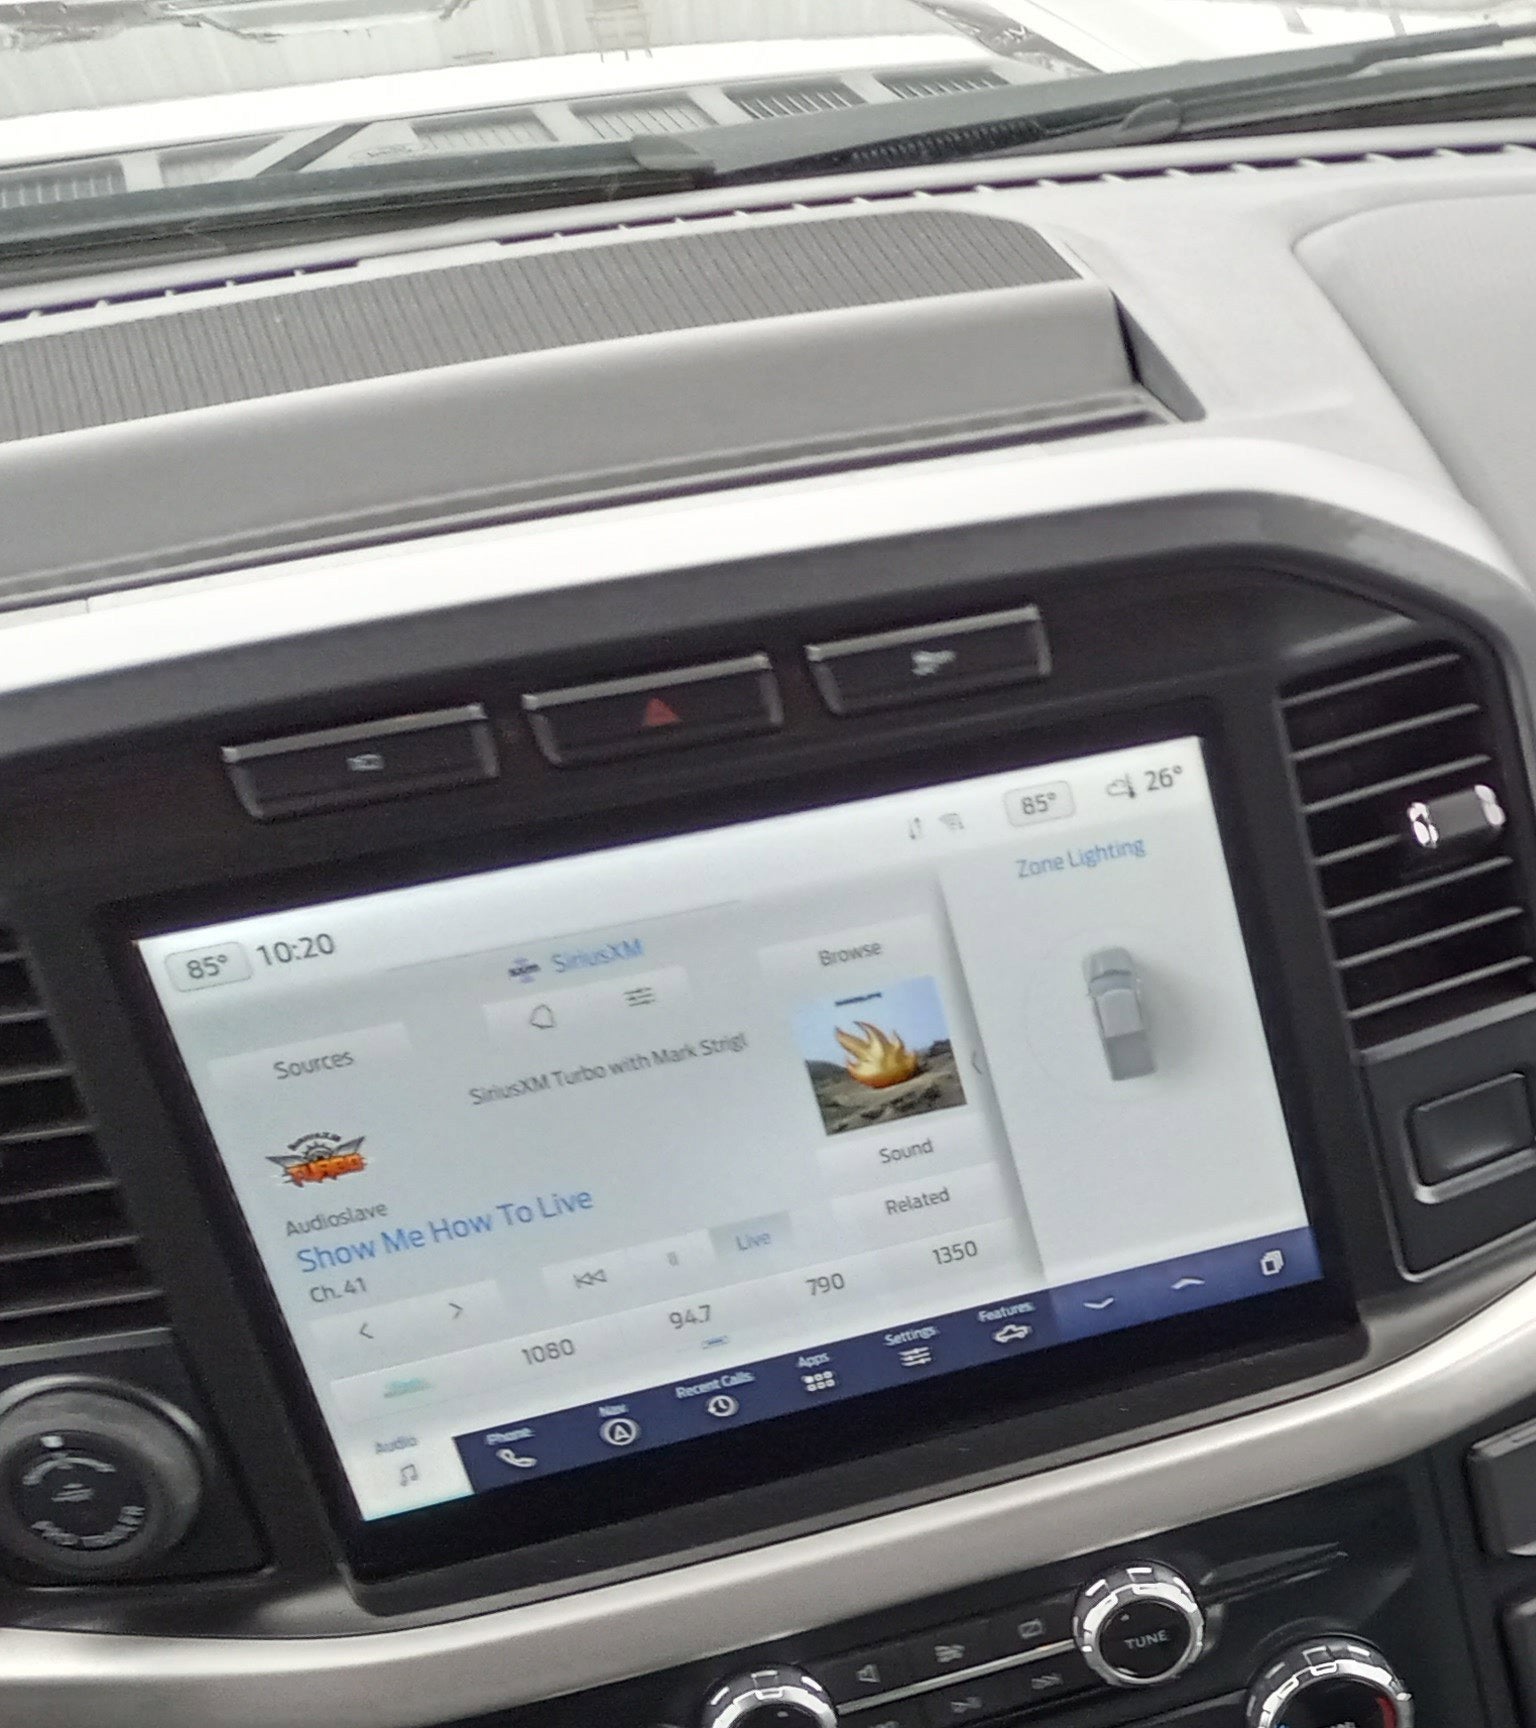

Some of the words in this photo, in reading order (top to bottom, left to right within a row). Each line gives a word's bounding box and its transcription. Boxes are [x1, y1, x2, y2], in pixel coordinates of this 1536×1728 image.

[1145, 764, 1184, 793] 26°
[1020, 790, 1057, 816] 85°
[1015, 858, 1064, 880] Zone
[1065, 838, 1147, 870] Lighting
[255, 933, 336, 967] 10:20
[551, 938, 646, 973] SiriusXM
[818, 941, 882, 967] Browse
[186, 953, 228, 980] 85°
[272, 1050, 355, 1081] Sources
[468, 1072, 550, 1105] SiriusXM
[551, 1064, 607, 1088] Turbo
[608, 1052, 652, 1076] with
[650, 1041, 698, 1065] Mark
[879, 1138, 934, 1164] Sound
[885, 1187, 951, 1217] Related
[286, 1200, 389, 1237] Audioslave
[296, 1238, 378, 1274] Show
[380, 1227, 427, 1254] Me
[429, 1212, 494, 1244] How
[497, 1202, 534, 1227] To
[537, 1190, 594, 1219] Live
[734, 1230, 773, 1252] Live
[932, 1240, 978, 1266] 1350
[344, 1277, 368, 1295] 41
[805, 1272, 846, 1297] 790
[669, 1304, 711, 1330] 94.7
[976, 1301, 1036, 1323] Features
[884, 1325, 938, 1347] Settings
[521, 1338, 576, 1366] 1080
[796, 1352, 831, 1370] Apps
[675, 1377, 720, 1399] Recent
[720, 1370, 756, 1388] Calls
[1123, 1629, 1170, 1650] TUNE
